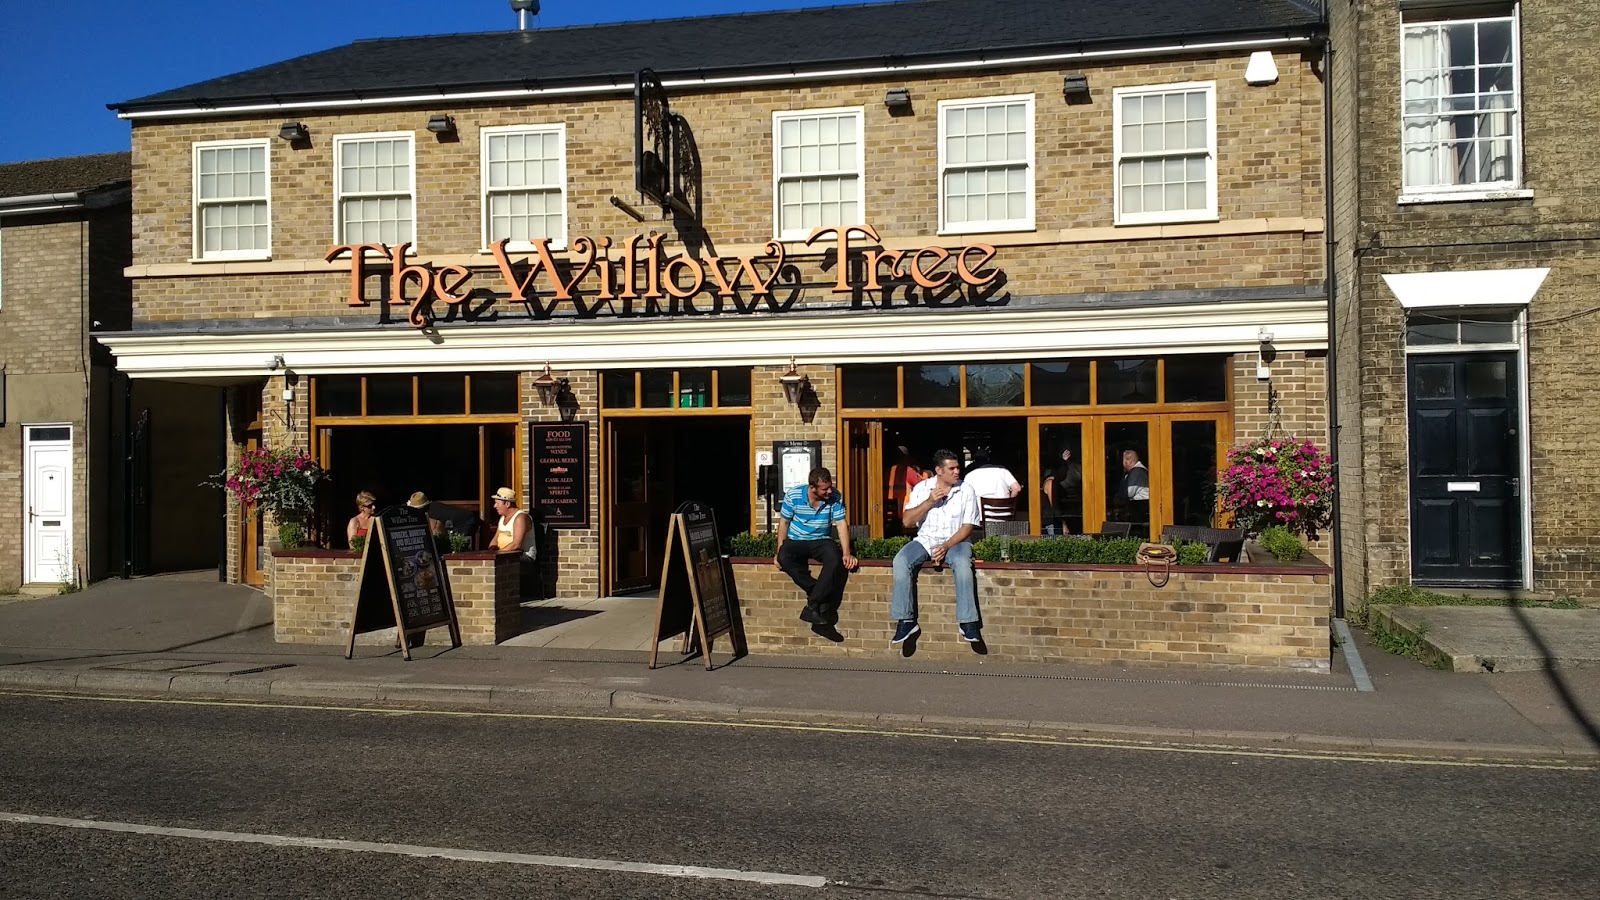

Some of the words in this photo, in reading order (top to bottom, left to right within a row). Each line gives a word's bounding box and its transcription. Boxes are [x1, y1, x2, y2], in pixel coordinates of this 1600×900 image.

[325, 242, 474, 328] The
[488, 230, 786, 302] Willow
[805, 224, 1000, 293] Tree
